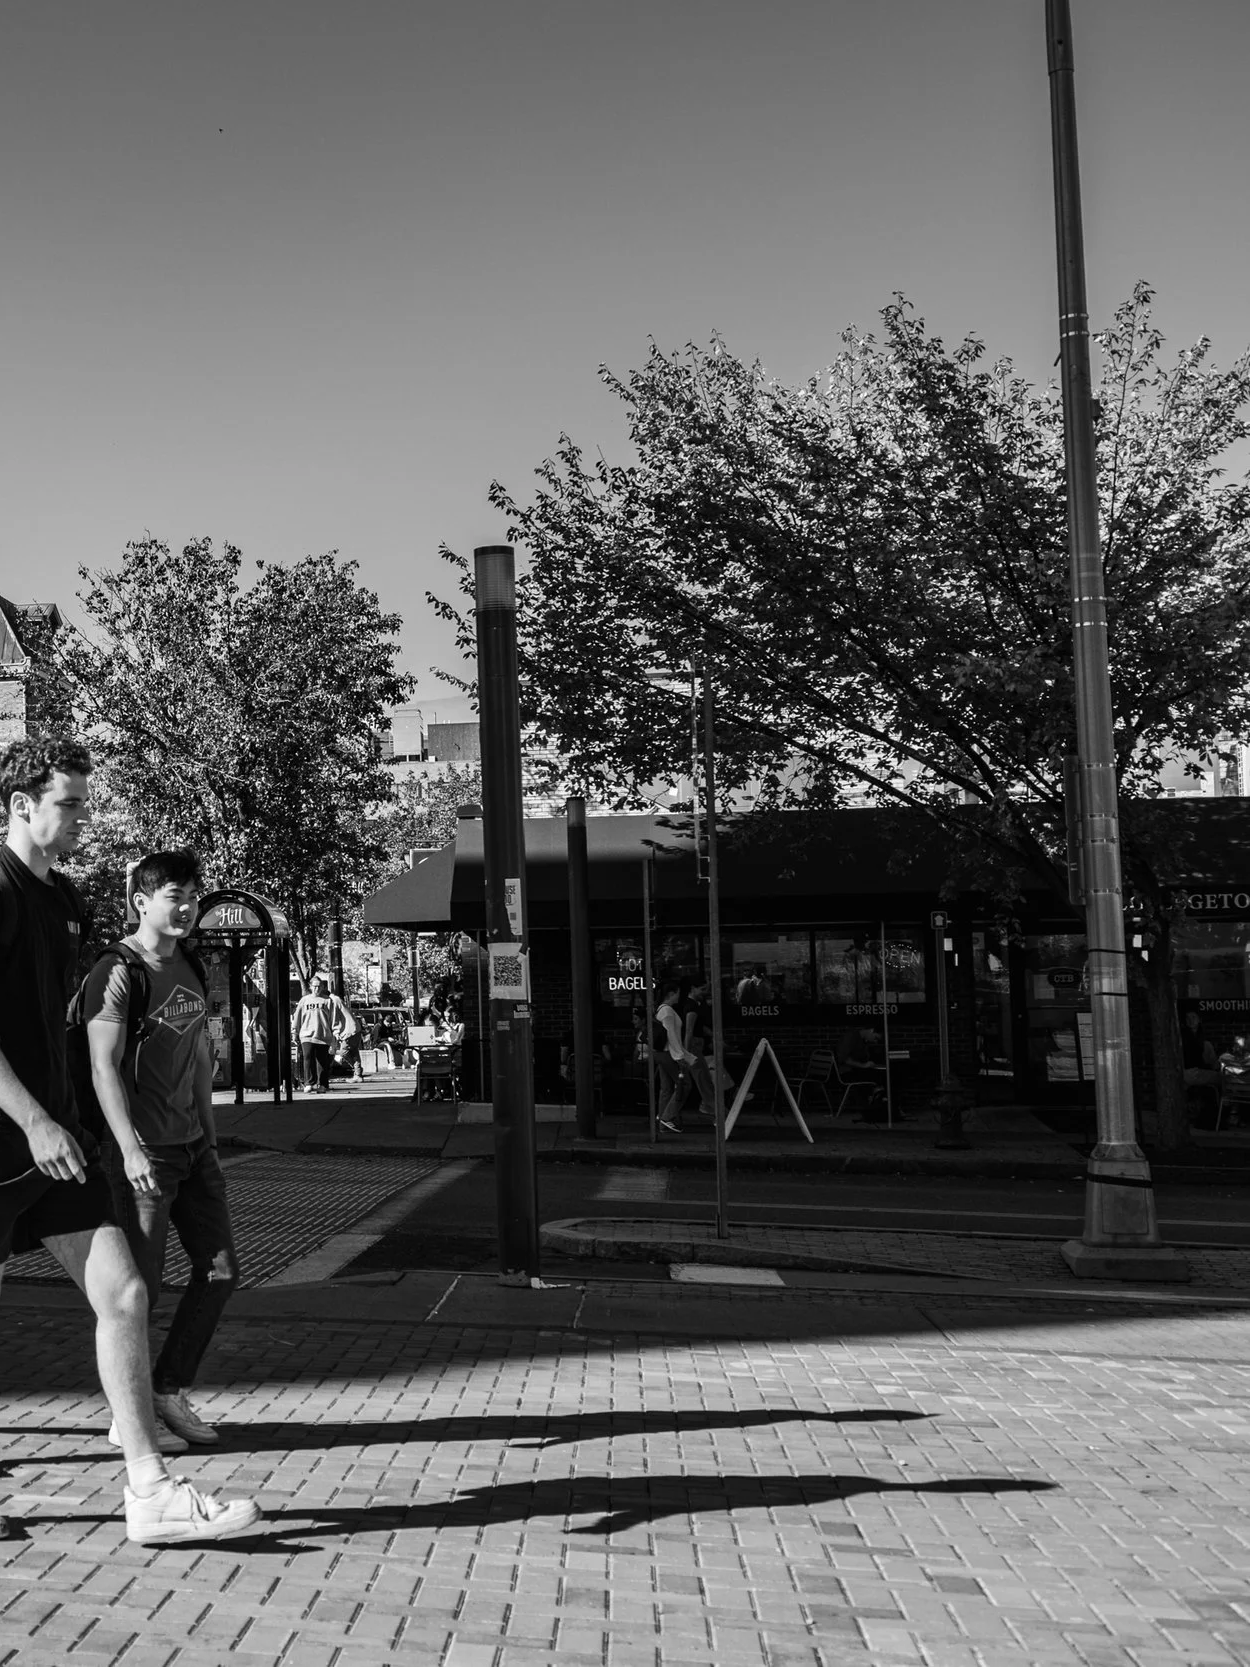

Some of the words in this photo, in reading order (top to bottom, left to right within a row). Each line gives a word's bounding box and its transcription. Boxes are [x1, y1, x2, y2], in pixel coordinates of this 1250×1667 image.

[218, 907, 244, 927] Hill
[878, 948, 921, 965] OPEN
[163, 999, 203, 1018] BILLABONG
[741, 1004, 780, 1016] BAGELS
[845, 1003, 899, 1016] ESPRESSO
[1199, 999, 1250, 1011] SMOOTHI
